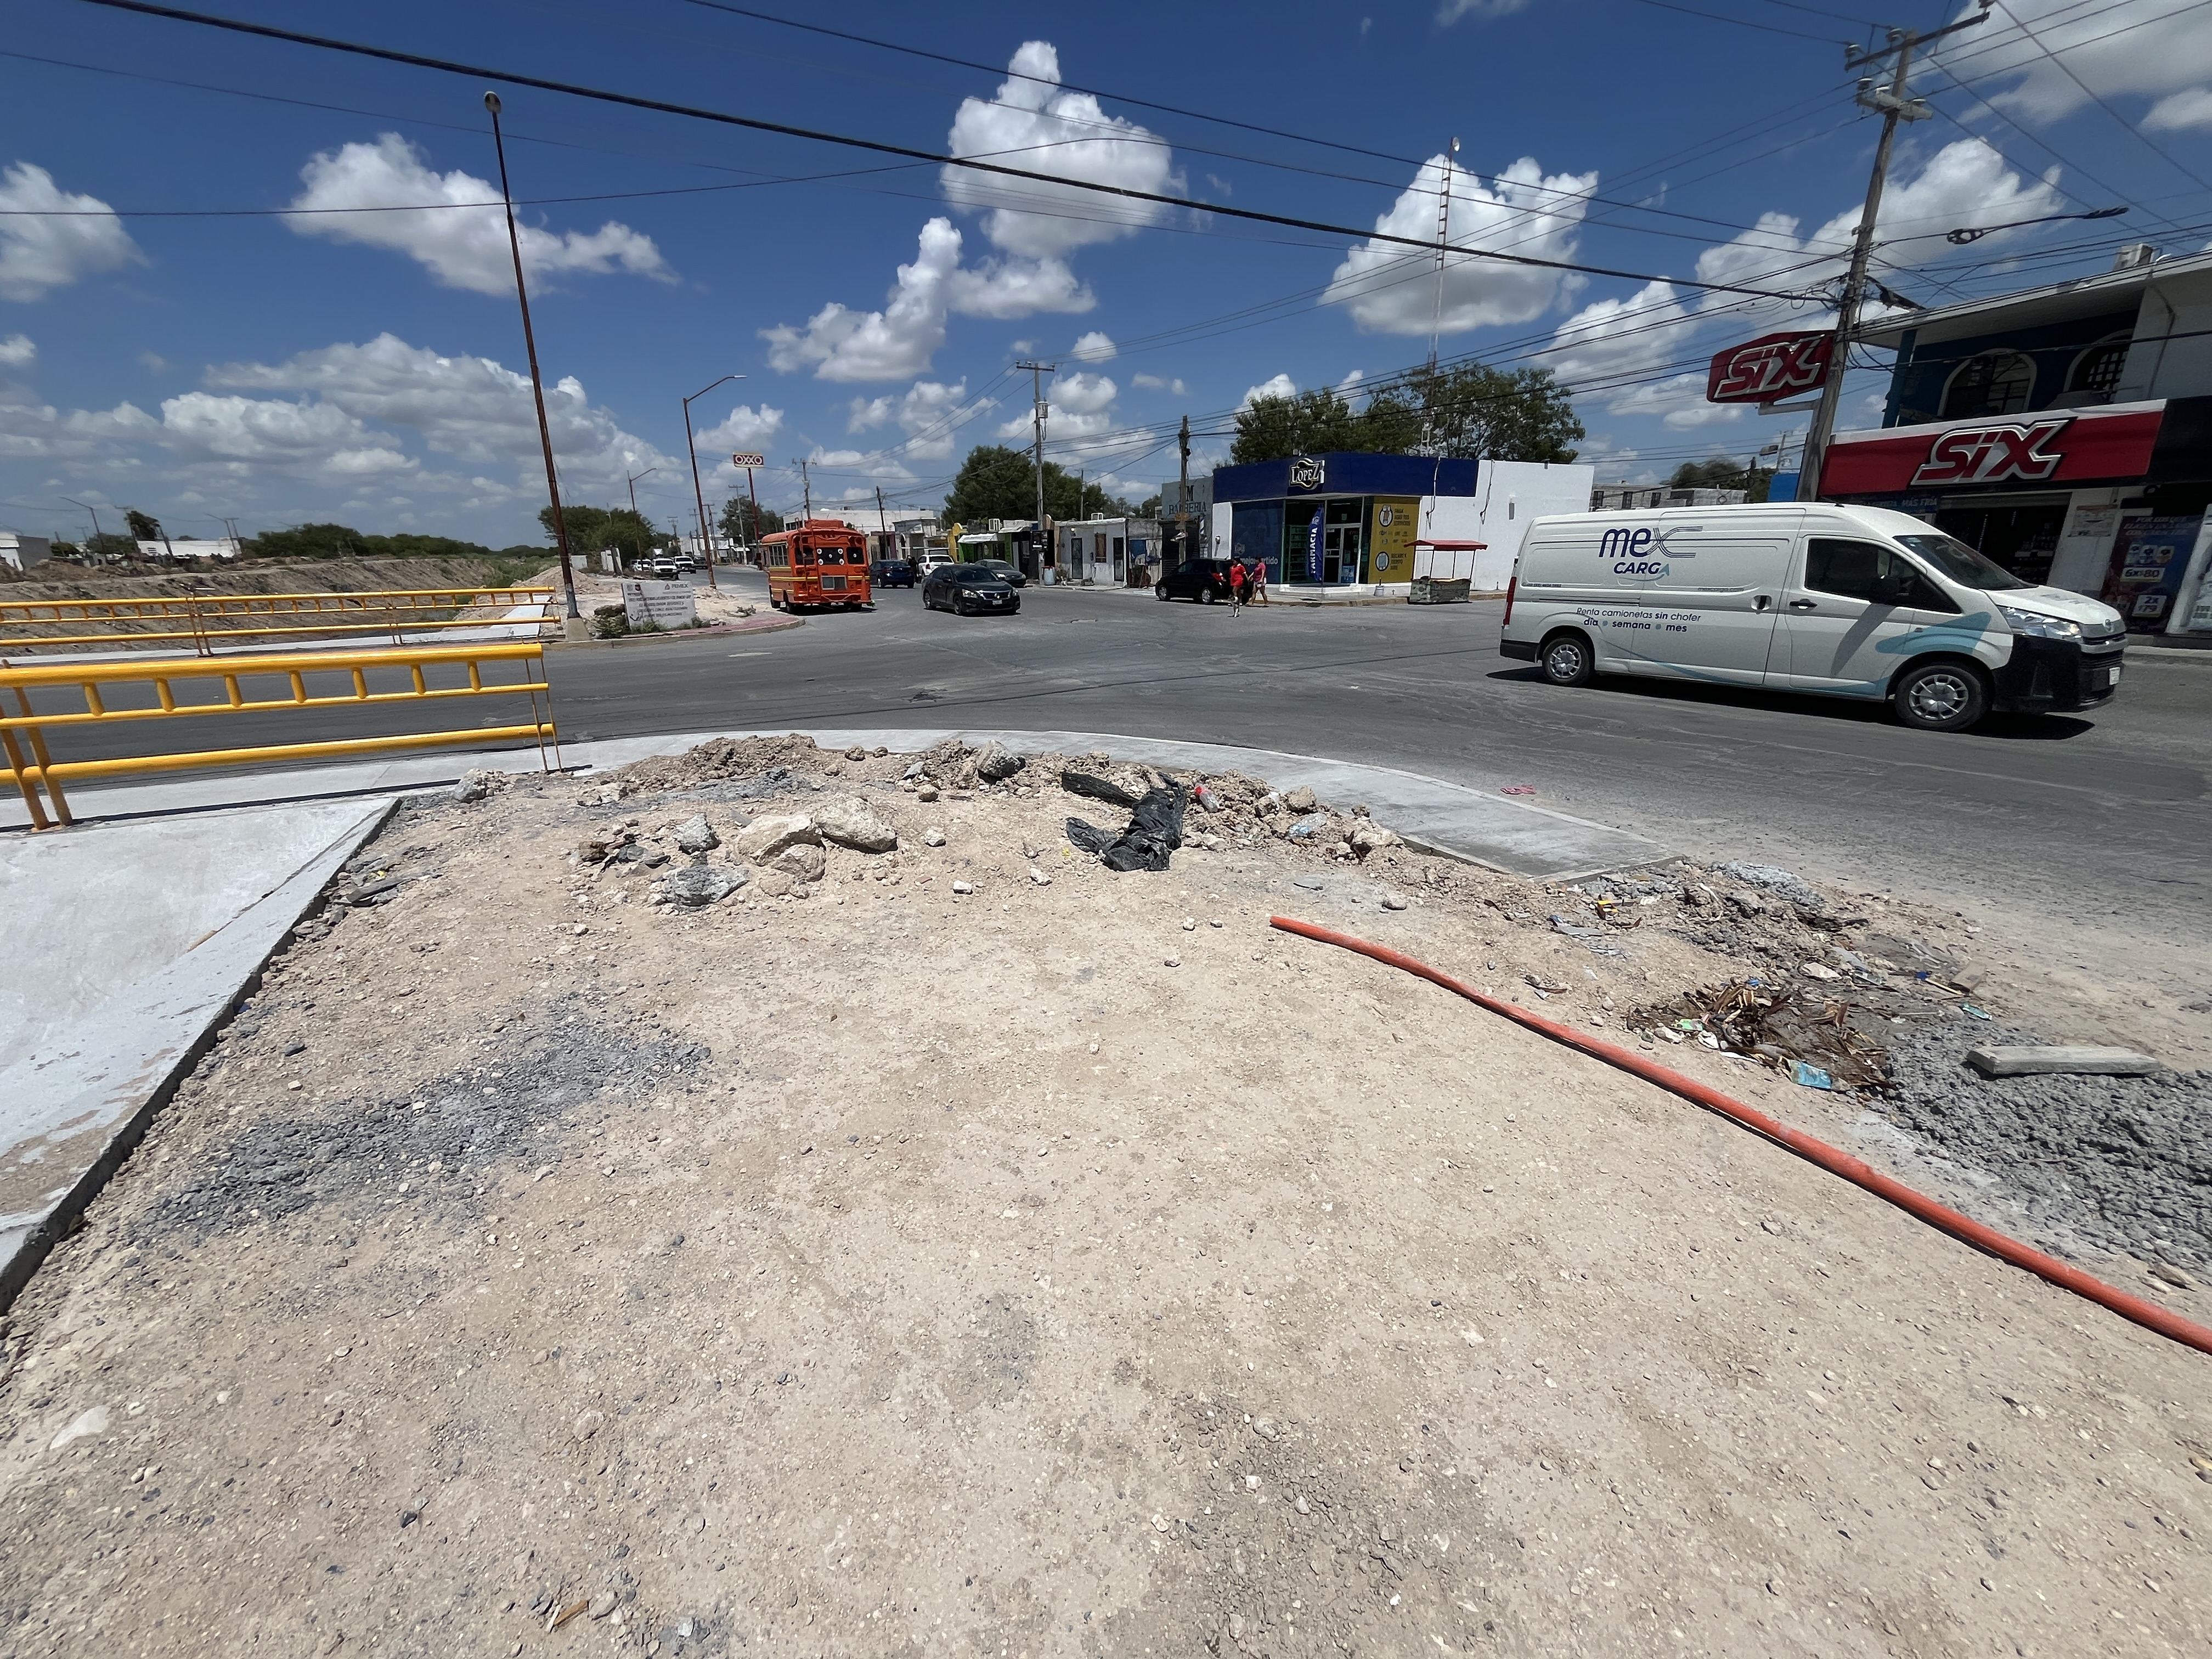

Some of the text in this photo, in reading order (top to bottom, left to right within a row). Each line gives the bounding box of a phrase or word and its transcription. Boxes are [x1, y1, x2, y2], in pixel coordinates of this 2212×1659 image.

[735, 455, 762, 465] OXXO
[1576, 607, 1701, 622] Renta camionetas sin chofer
[1612, 620, 1651, 630] semana
[1666, 624, 1688, 633] mes
